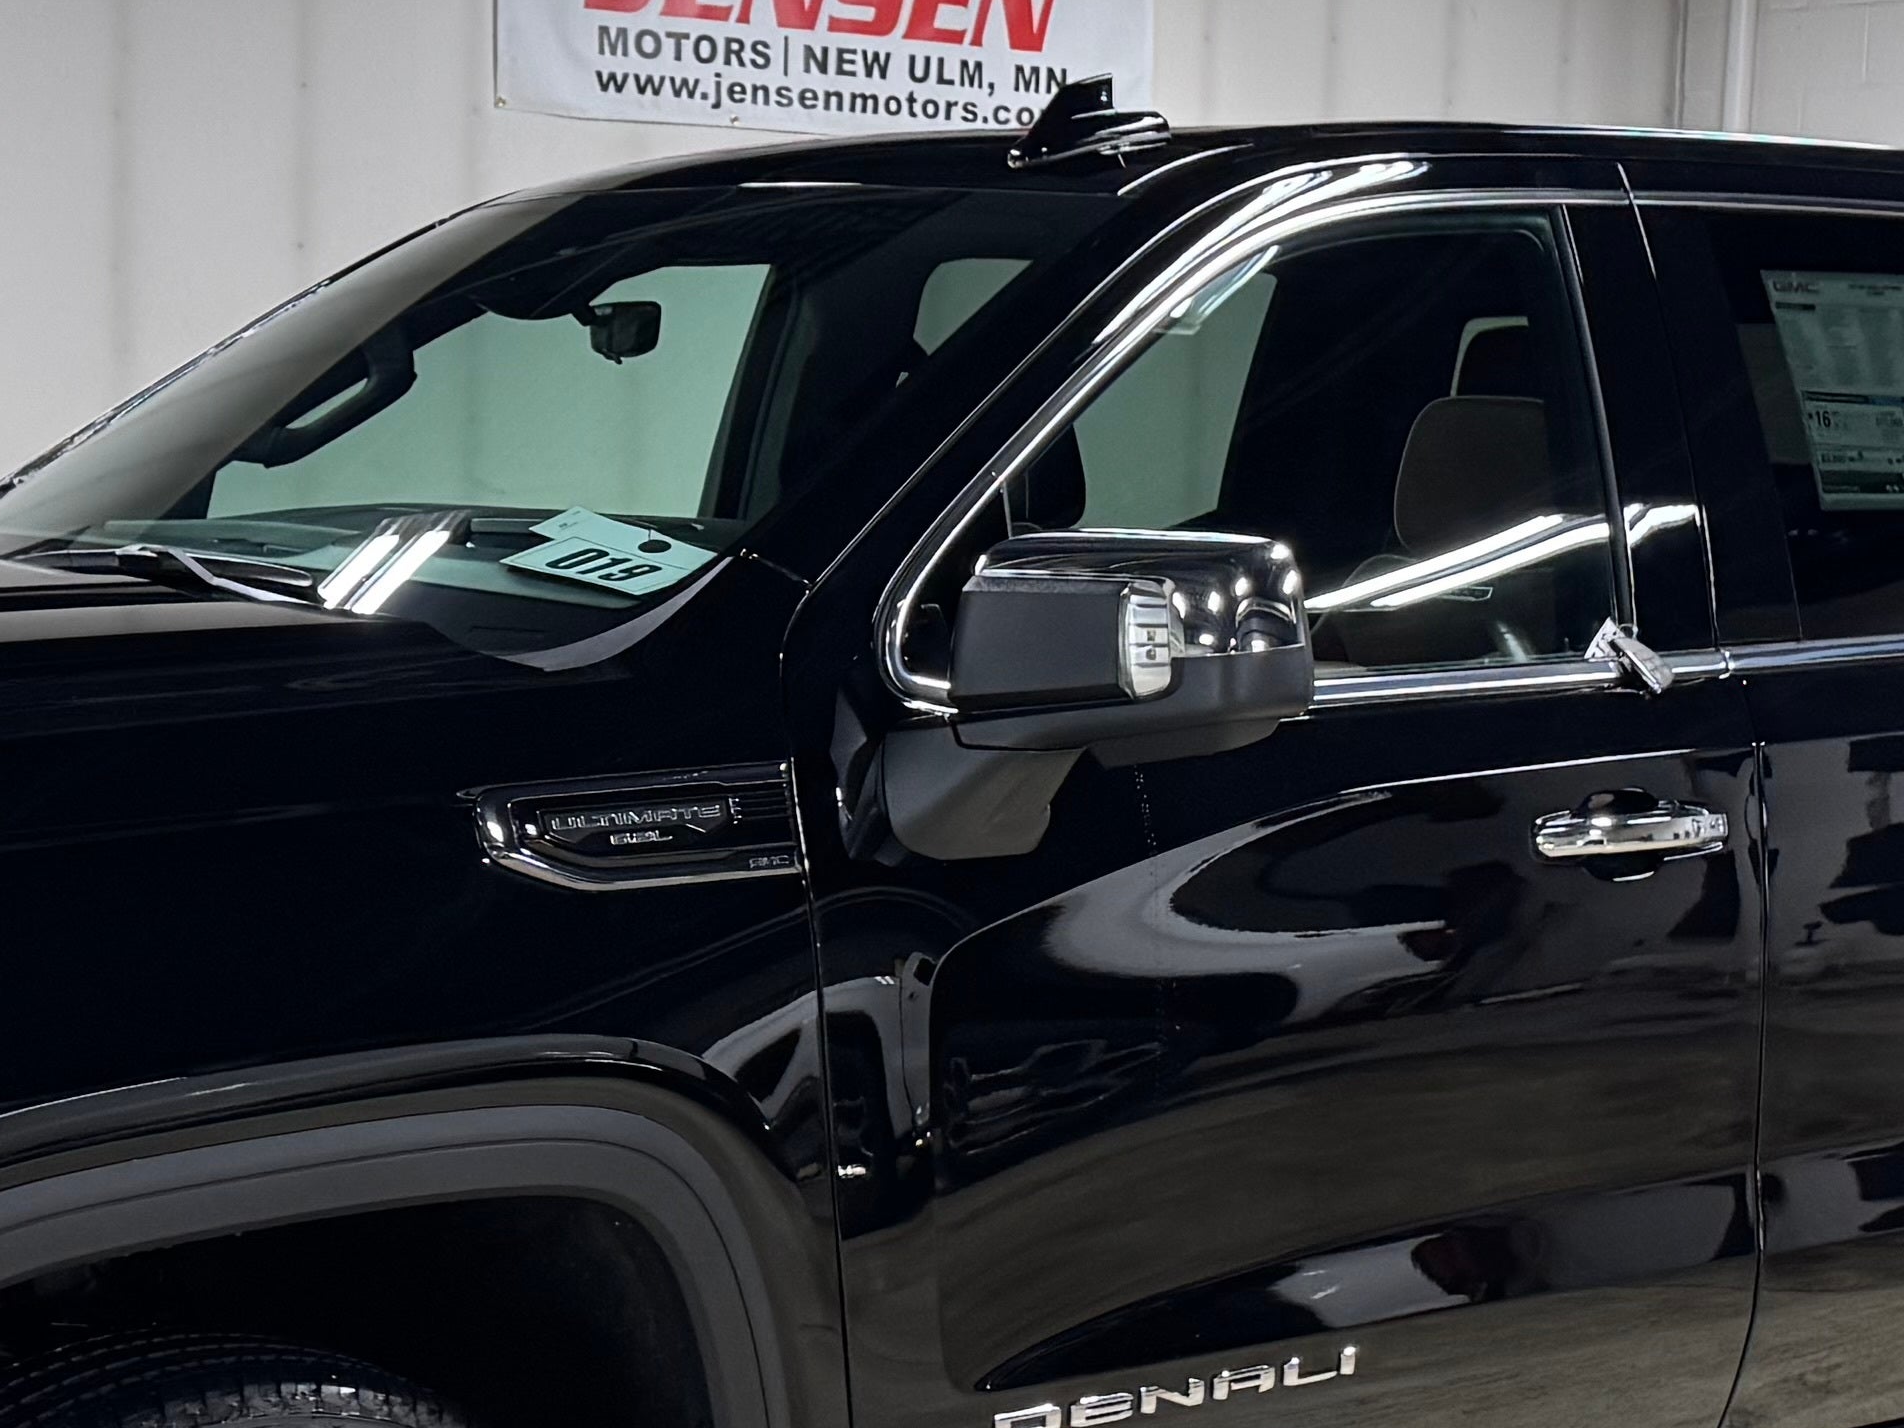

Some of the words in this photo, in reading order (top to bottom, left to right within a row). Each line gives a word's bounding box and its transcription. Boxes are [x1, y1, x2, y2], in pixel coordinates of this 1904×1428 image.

[598, 25, 772, 70] MOTORS
[803, 44, 891, 80] NEW
[908, 54, 995, 97] ULM,
[1014, 64, 1067, 94] MN
[595, 70, 1046, 126] www.jensenmotors.co
[545, 548, 663, 582] 019
[551, 803, 721, 831] ULTIMATE
